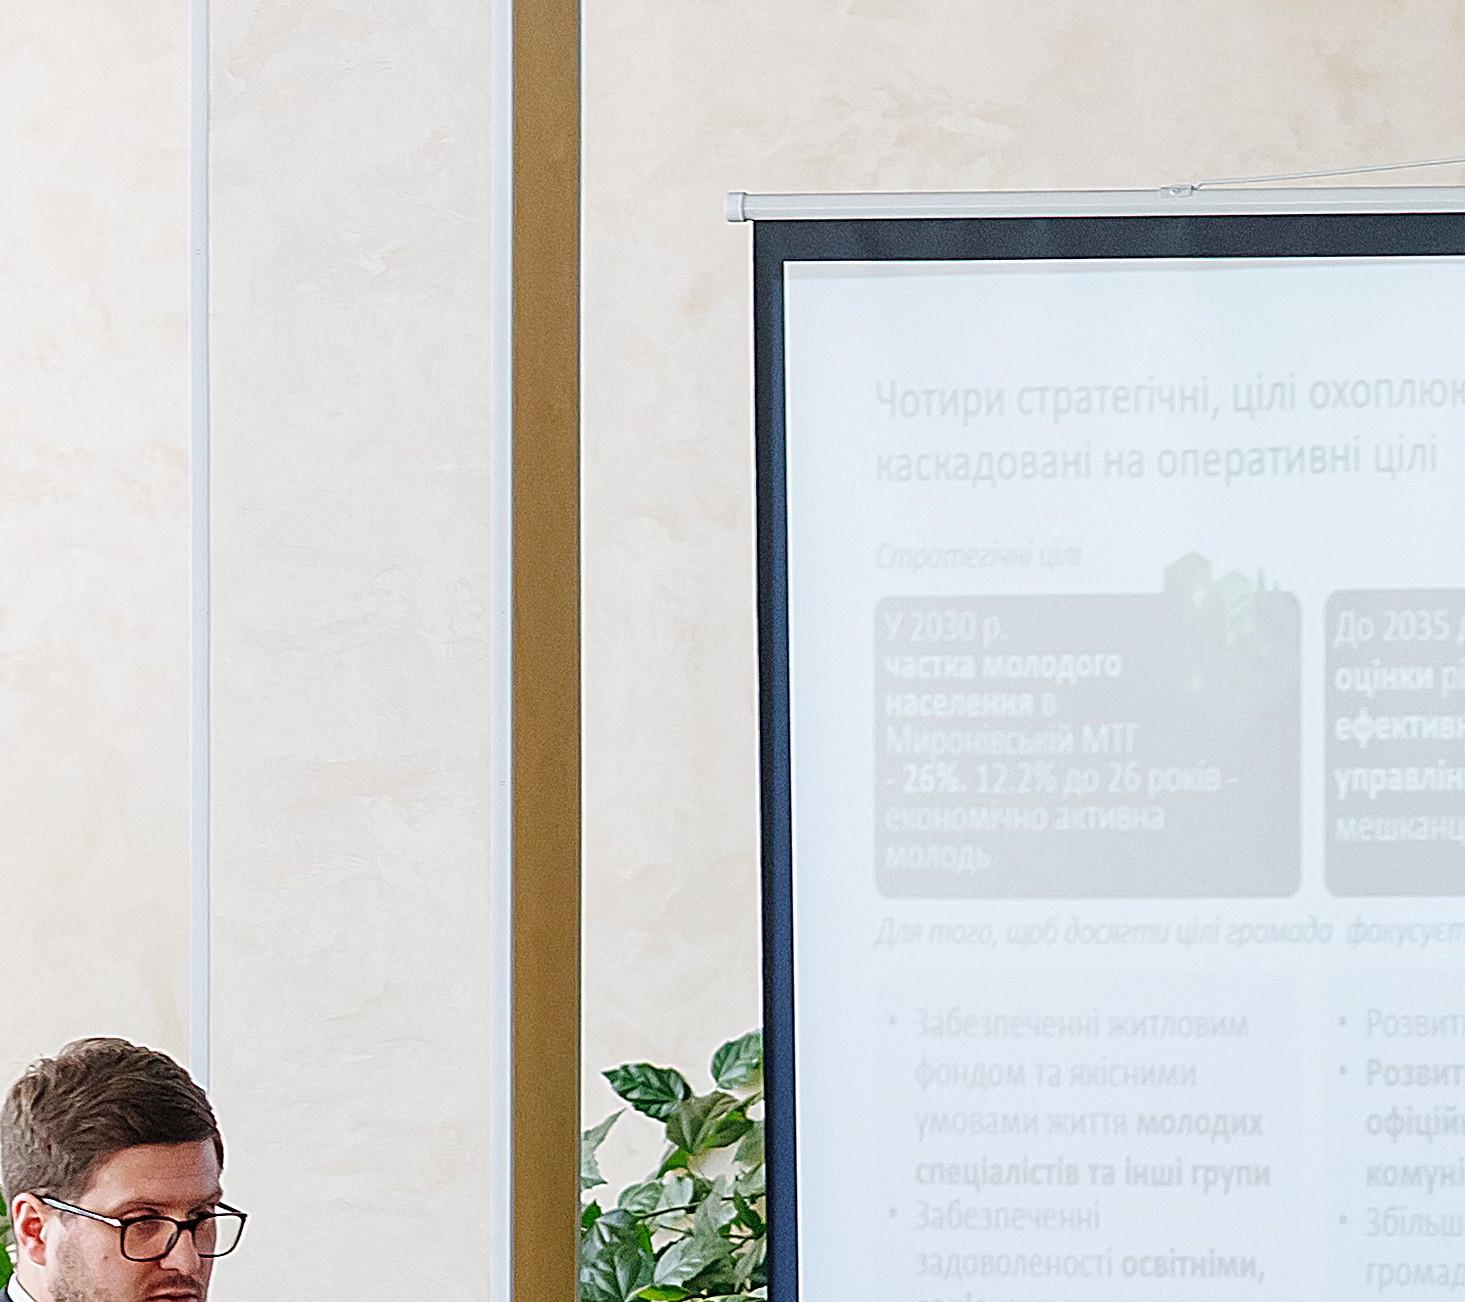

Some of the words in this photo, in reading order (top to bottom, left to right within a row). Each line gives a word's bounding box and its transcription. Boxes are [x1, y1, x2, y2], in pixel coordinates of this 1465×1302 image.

[875, 379, 1006, 425] Чотири
[1016, 375, 1220, 424] стратегічні,
[1233, 372, 1297, 418] цілі
[876, 440, 1092, 487] каскадовані
[1104, 446, 1145, 478] на
[1157, 434, 1360, 485] оперативні
[1373, 434, 1438, 479] цілі
[1335, 612, 1375, 649] До
[1383, 610, 1450, 641] 2035
